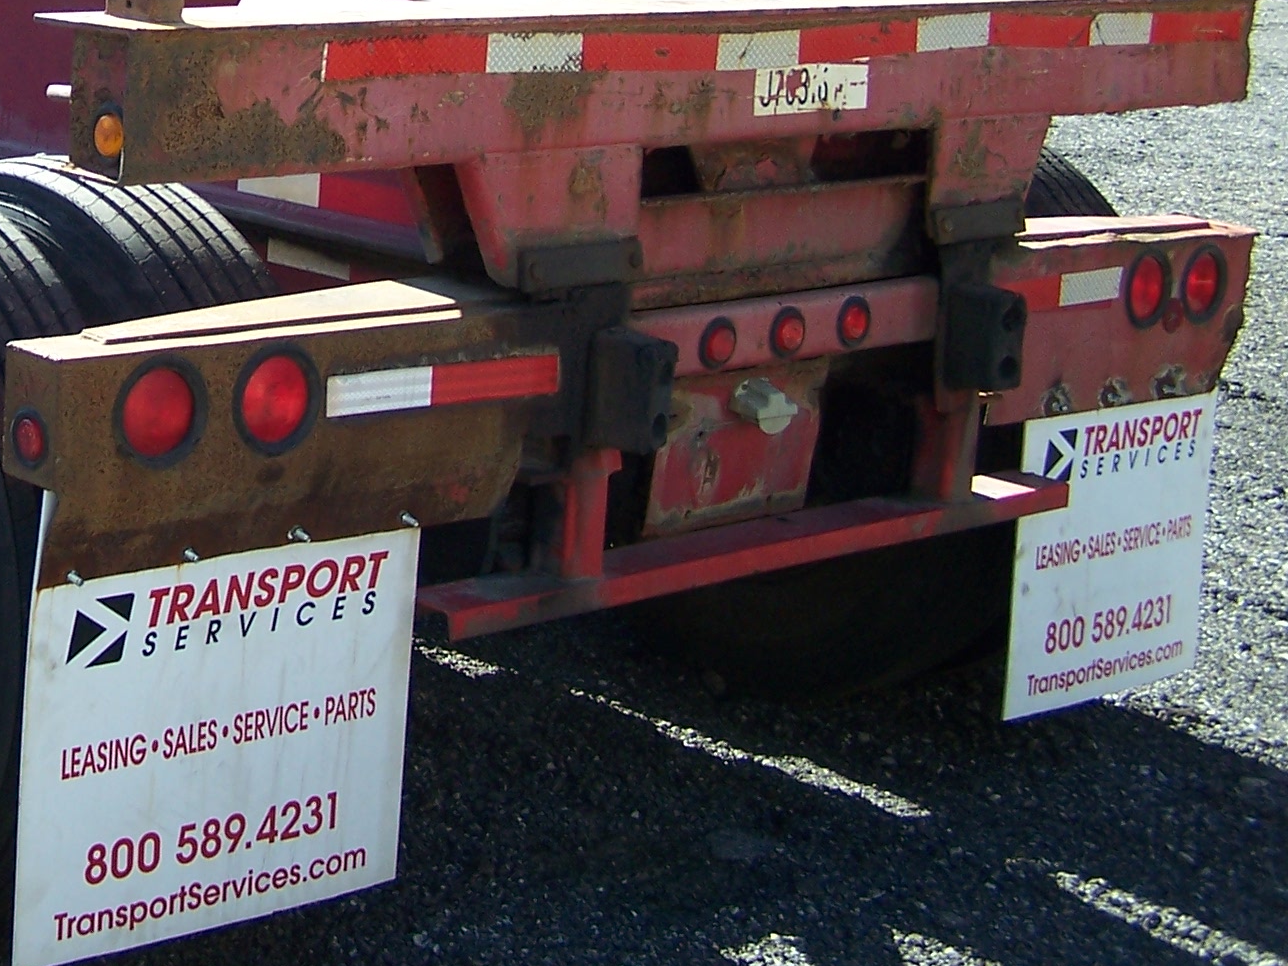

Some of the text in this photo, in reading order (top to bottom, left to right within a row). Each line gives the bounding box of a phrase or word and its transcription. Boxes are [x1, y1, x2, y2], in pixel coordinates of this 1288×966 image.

[1079, 439, 1197, 478] SERVICES
[1083, 408, 1203, 457] TRANSPORT
[1035, 514, 1192, 570] LEASING SALES SERVICE PARTS
[148, 550, 390, 628] TRANSPORT
[142, 591, 377, 658] SERVICES
[1044, 594, 1172, 655] 800 589.4231
[1027, 639, 1183, 696] TransportServices.com
[61, 687, 376, 781] LEASING SALES SERVICE PARTS
[84, 791, 338, 885] 800 589.4231
[54, 847, 366, 941] TransportServices.com
